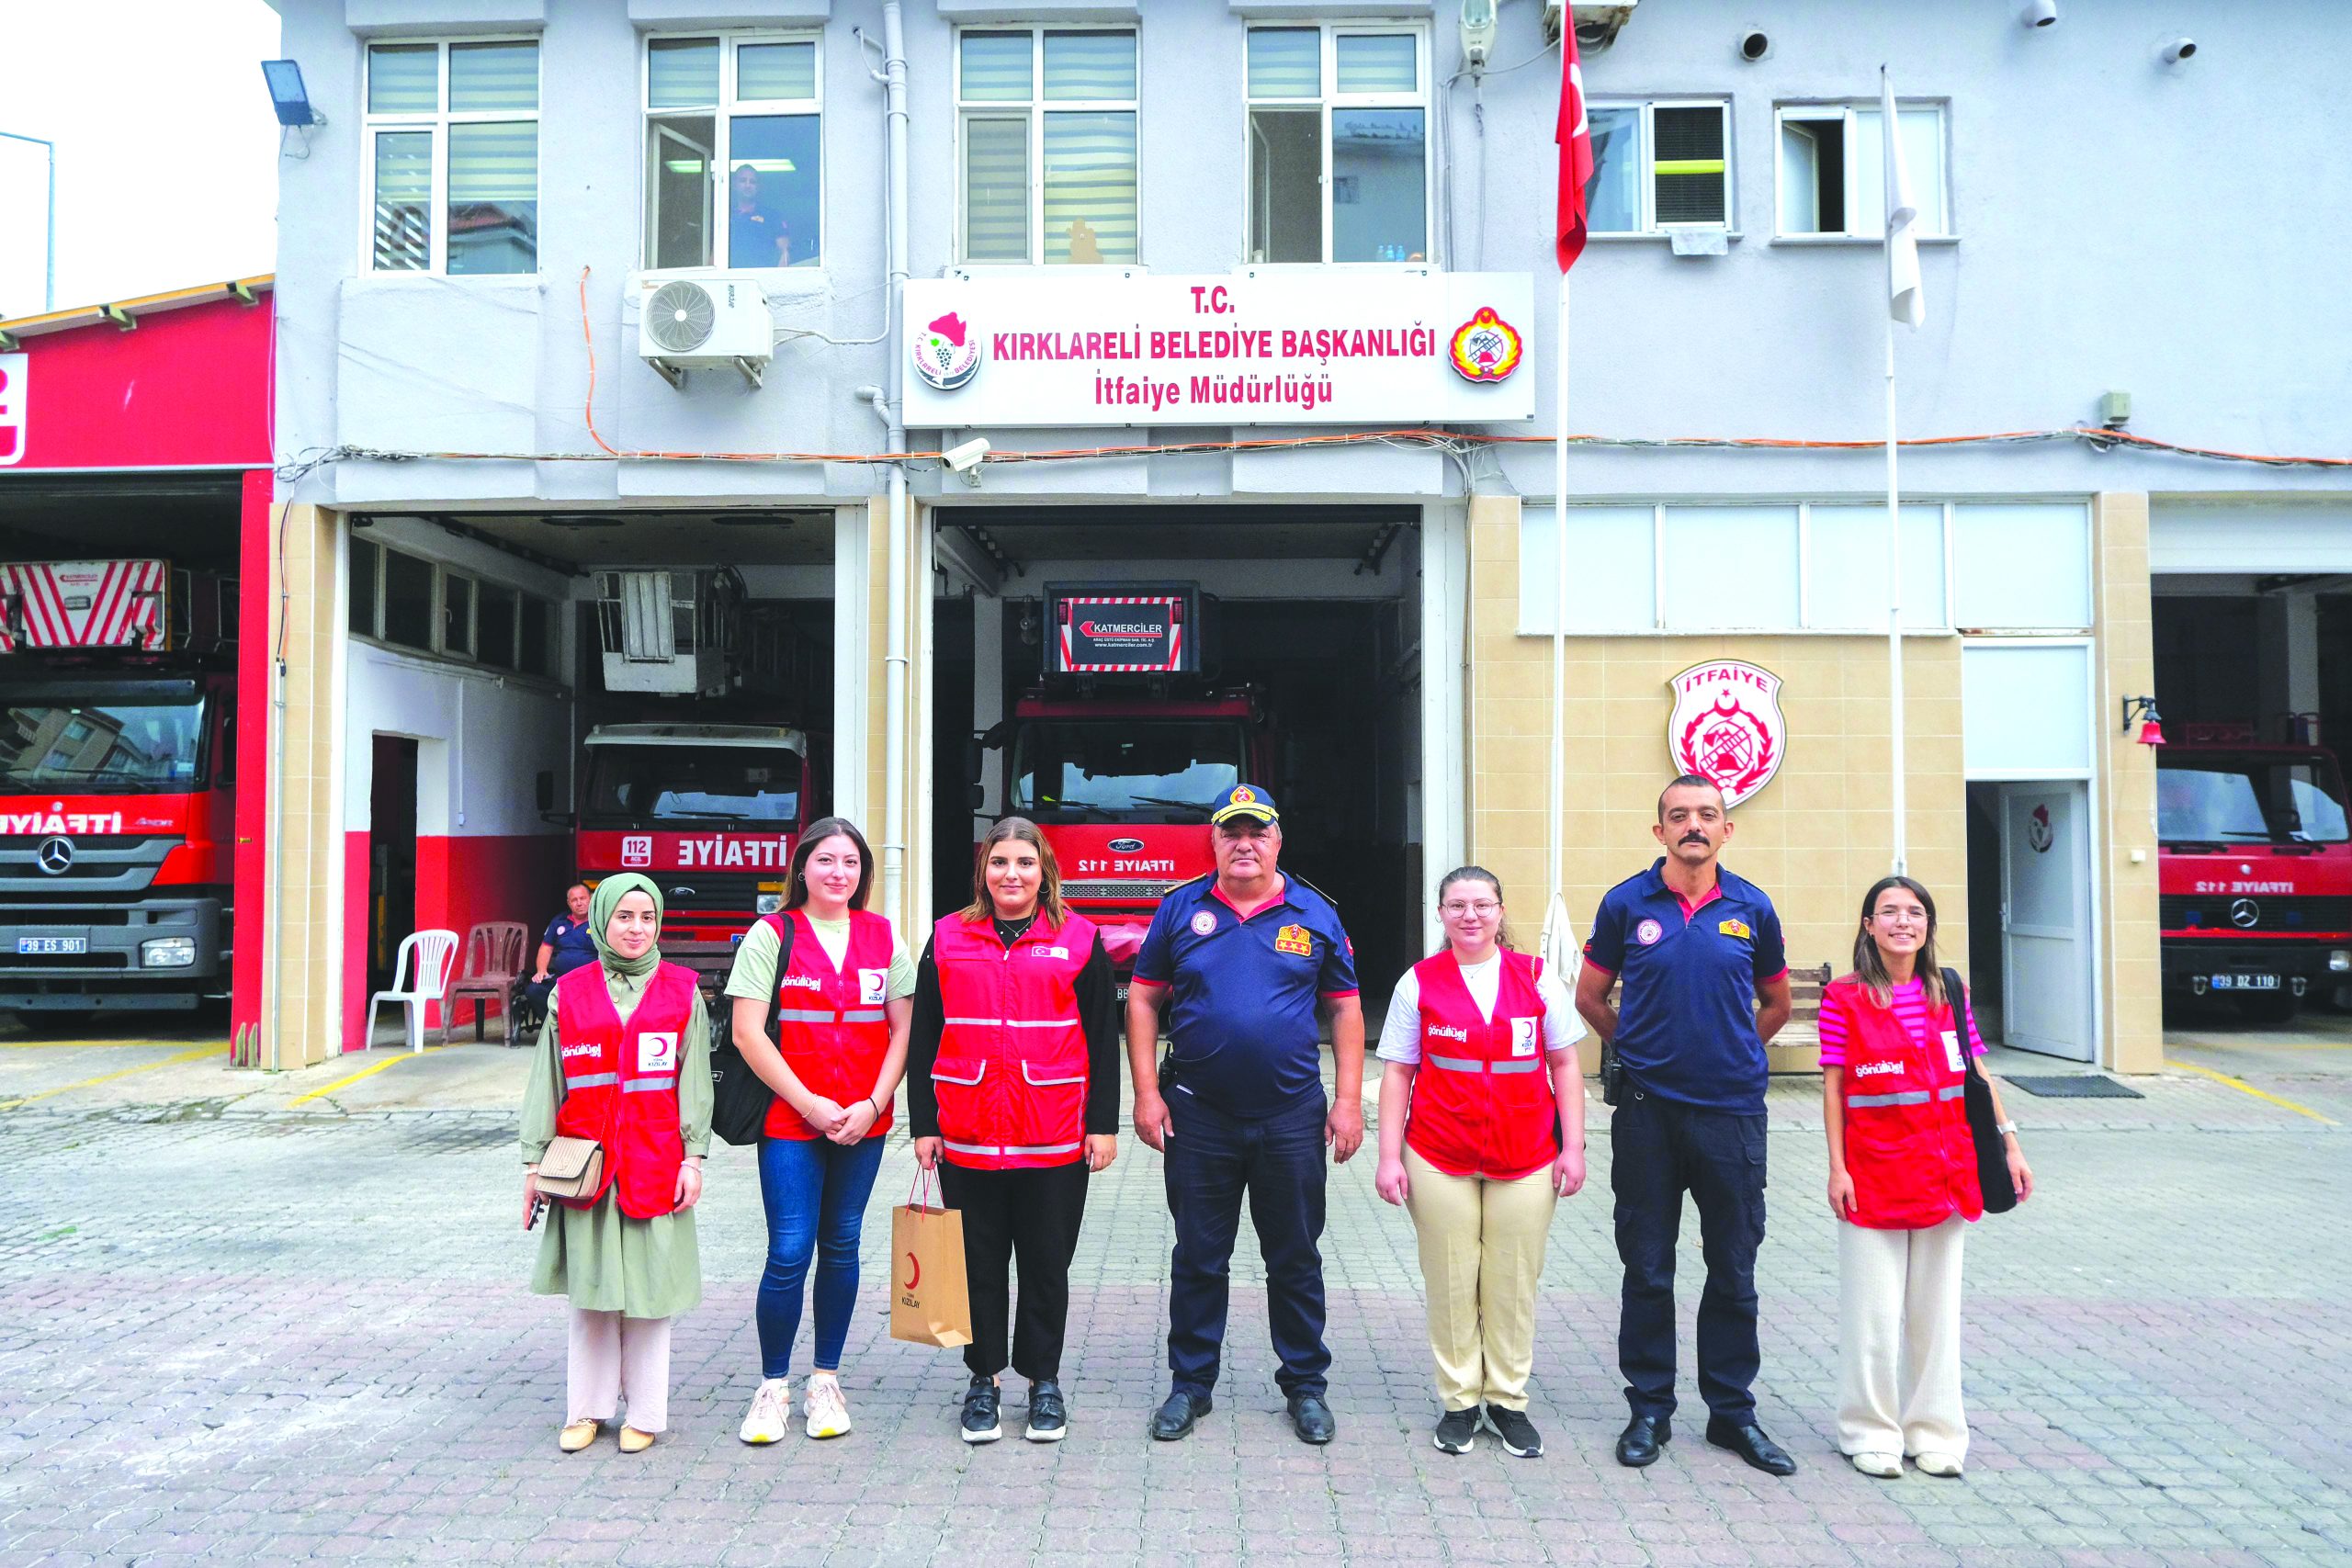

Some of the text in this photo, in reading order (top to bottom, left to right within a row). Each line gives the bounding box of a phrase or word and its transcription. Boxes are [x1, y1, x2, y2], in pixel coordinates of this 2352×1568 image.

[1191, 286, 1235, 314] T.C.
[993, 321, 1435, 366] KIRKLARELİ BELEDİYE BAŞKANLIĞI
[1096, 369, 1332, 412] İtfaiye Müdürlüğü
[1094, 623, 1162, 633] KATMERCİLER
[1686, 666, 1769, 694] İTFAİYE
[628, 840, 647, 853] 112
[1115, 840, 1136, 850] Ford
[27, 941, 80, 951] 39 ES 901
